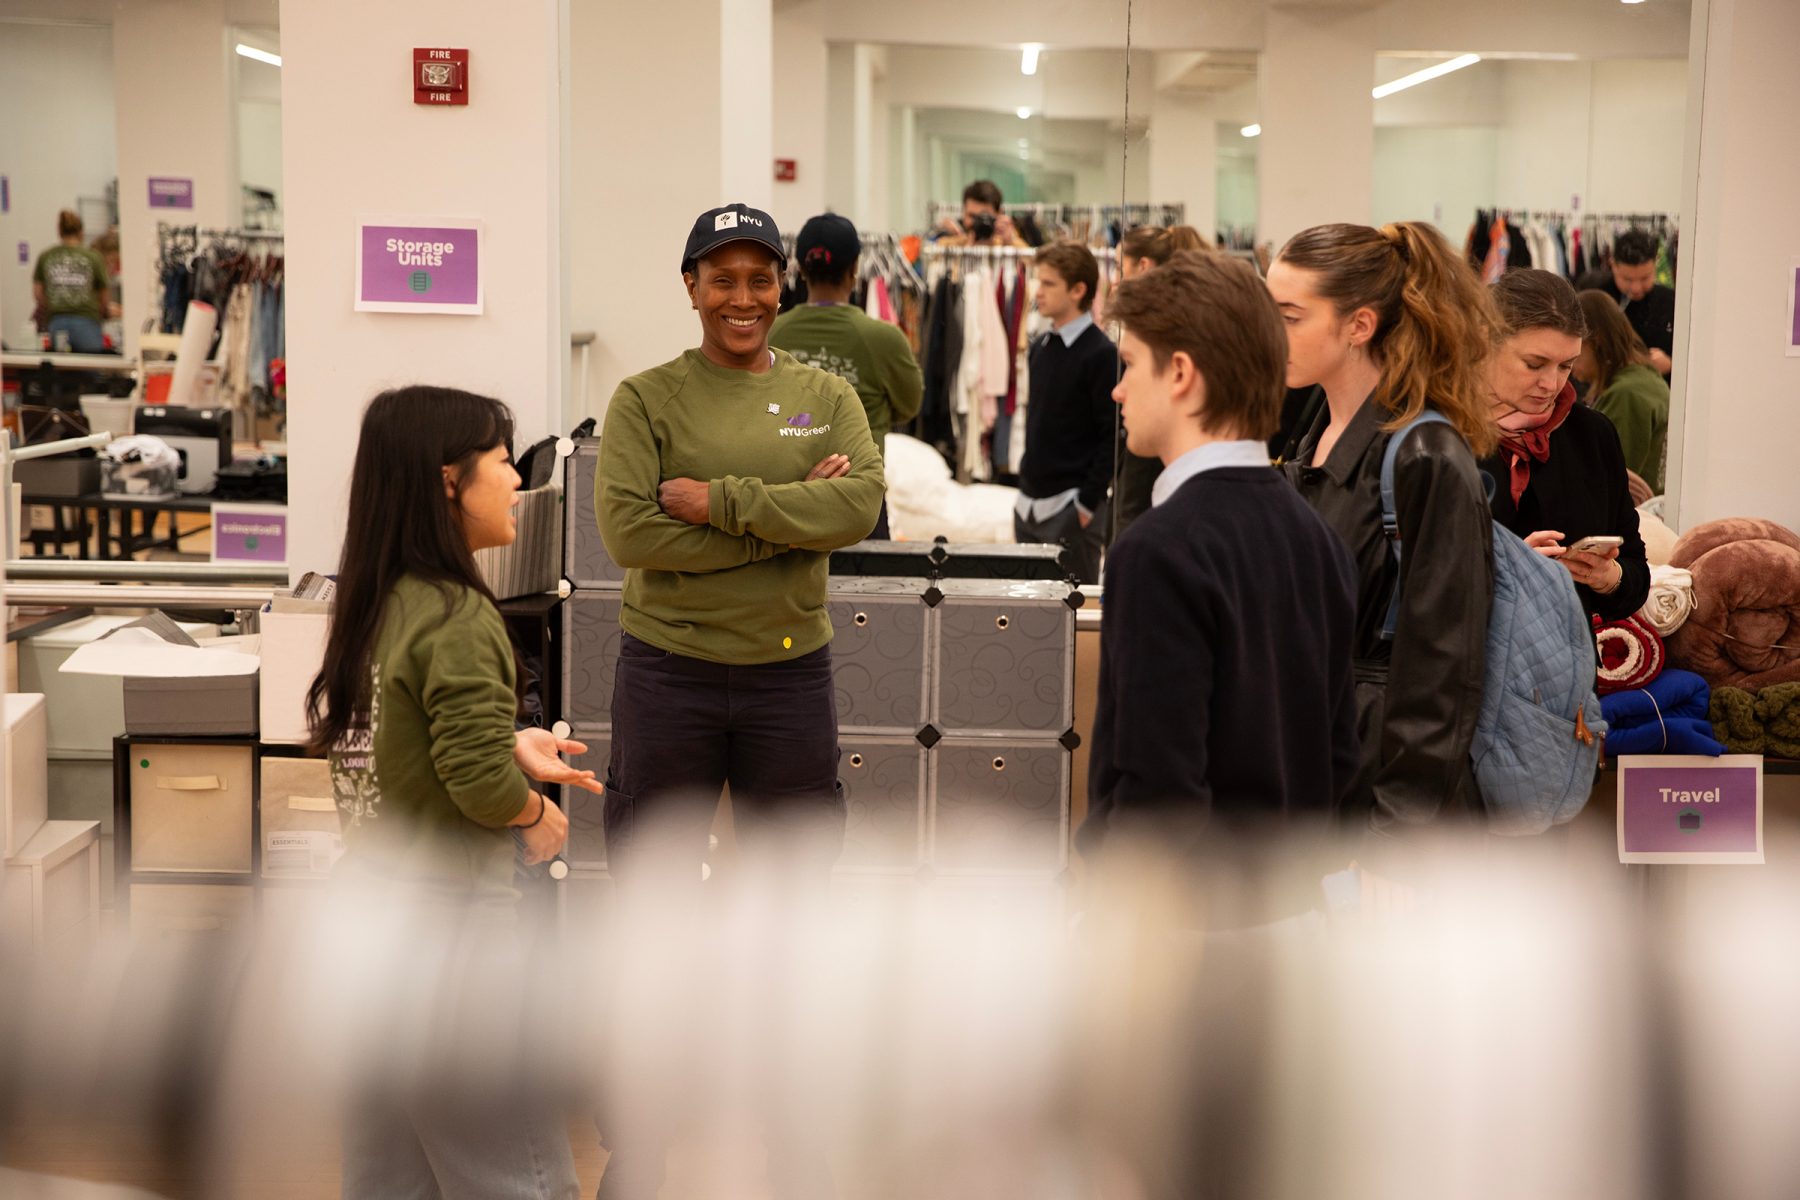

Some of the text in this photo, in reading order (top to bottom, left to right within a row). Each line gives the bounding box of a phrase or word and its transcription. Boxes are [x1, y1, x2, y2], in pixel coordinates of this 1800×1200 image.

[430, 50, 451, 59] FIRE
[430, 93, 452, 102] FIRE
[740, 214, 763, 228] NYU
[386, 238, 455, 256] Storage
[398, 252, 443, 267] Units
[1658, 787, 1720, 803] Travel
